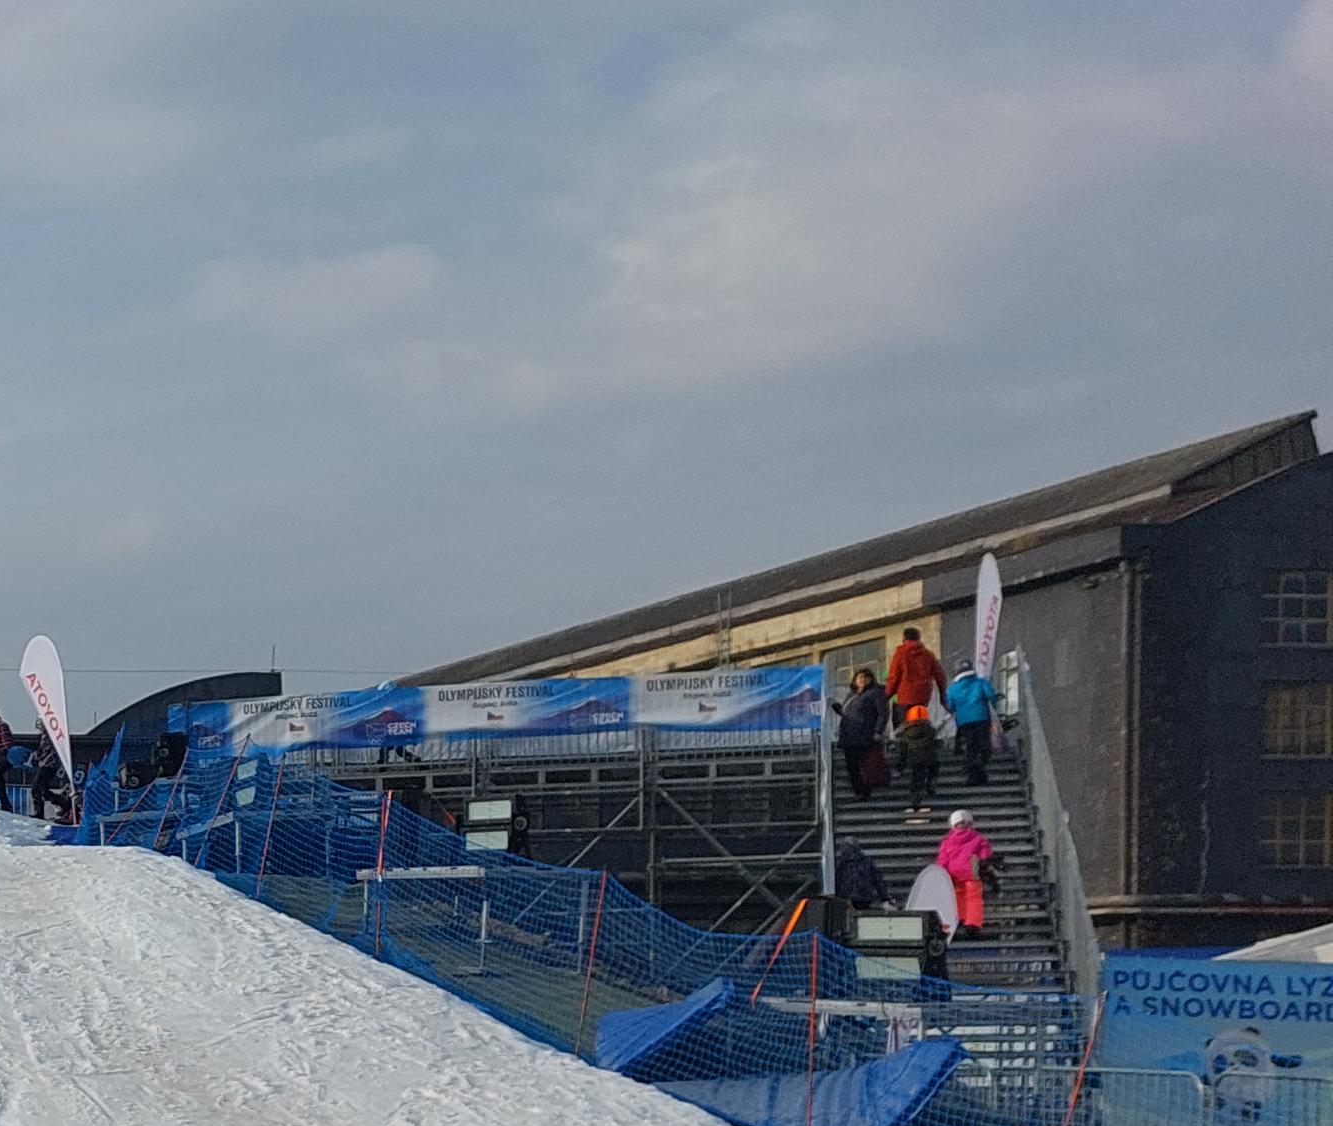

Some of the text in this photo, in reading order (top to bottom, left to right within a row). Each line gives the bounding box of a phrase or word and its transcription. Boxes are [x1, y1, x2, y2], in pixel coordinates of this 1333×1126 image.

[505, 684, 556, 698] FESTIVAL
[305, 696, 352, 710] FESTIVAL
[1113, 995, 1132, 1015] A
